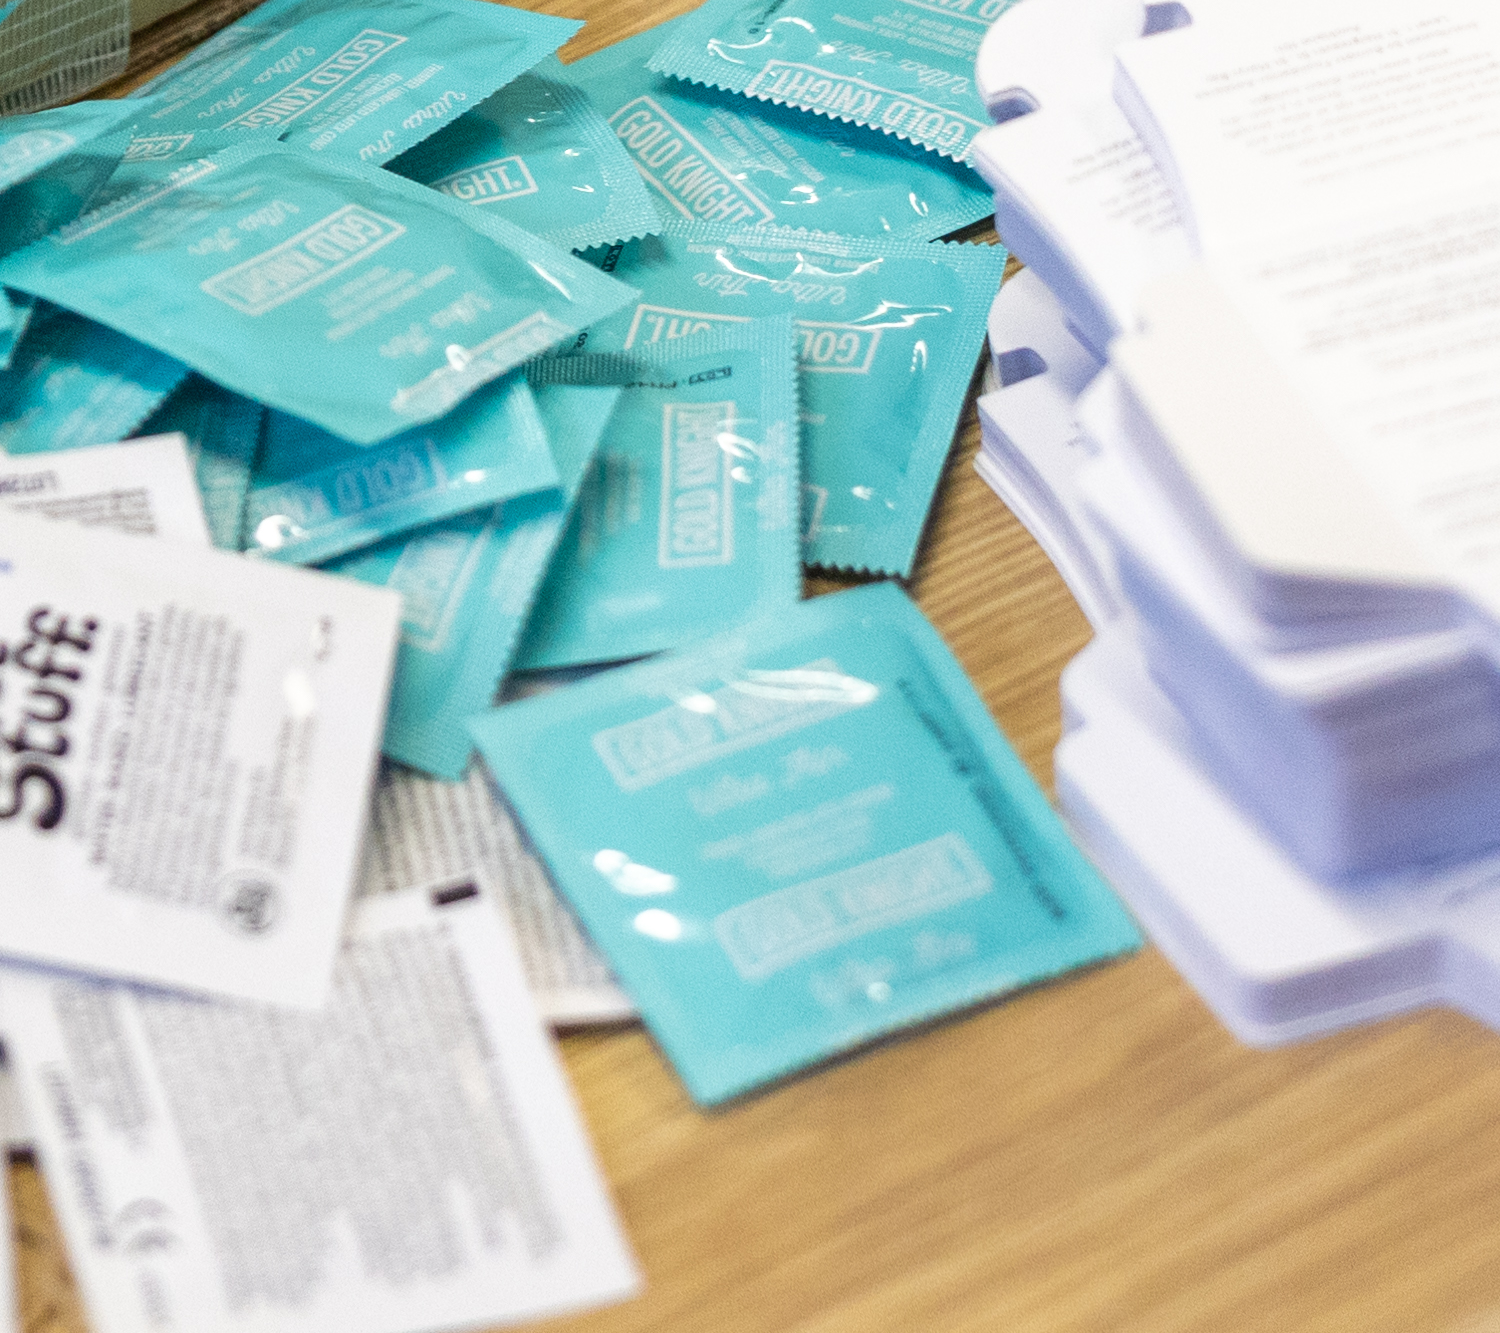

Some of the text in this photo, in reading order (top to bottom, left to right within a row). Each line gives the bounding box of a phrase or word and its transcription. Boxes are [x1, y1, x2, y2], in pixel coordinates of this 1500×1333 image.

[308, 26, 387, 96] GOLD
[613, 102, 685, 174] GOLD
[878, 95, 968, 152] GOLD
[301, 204, 384, 270] GOLD
[791, 323, 861, 367] GOL
